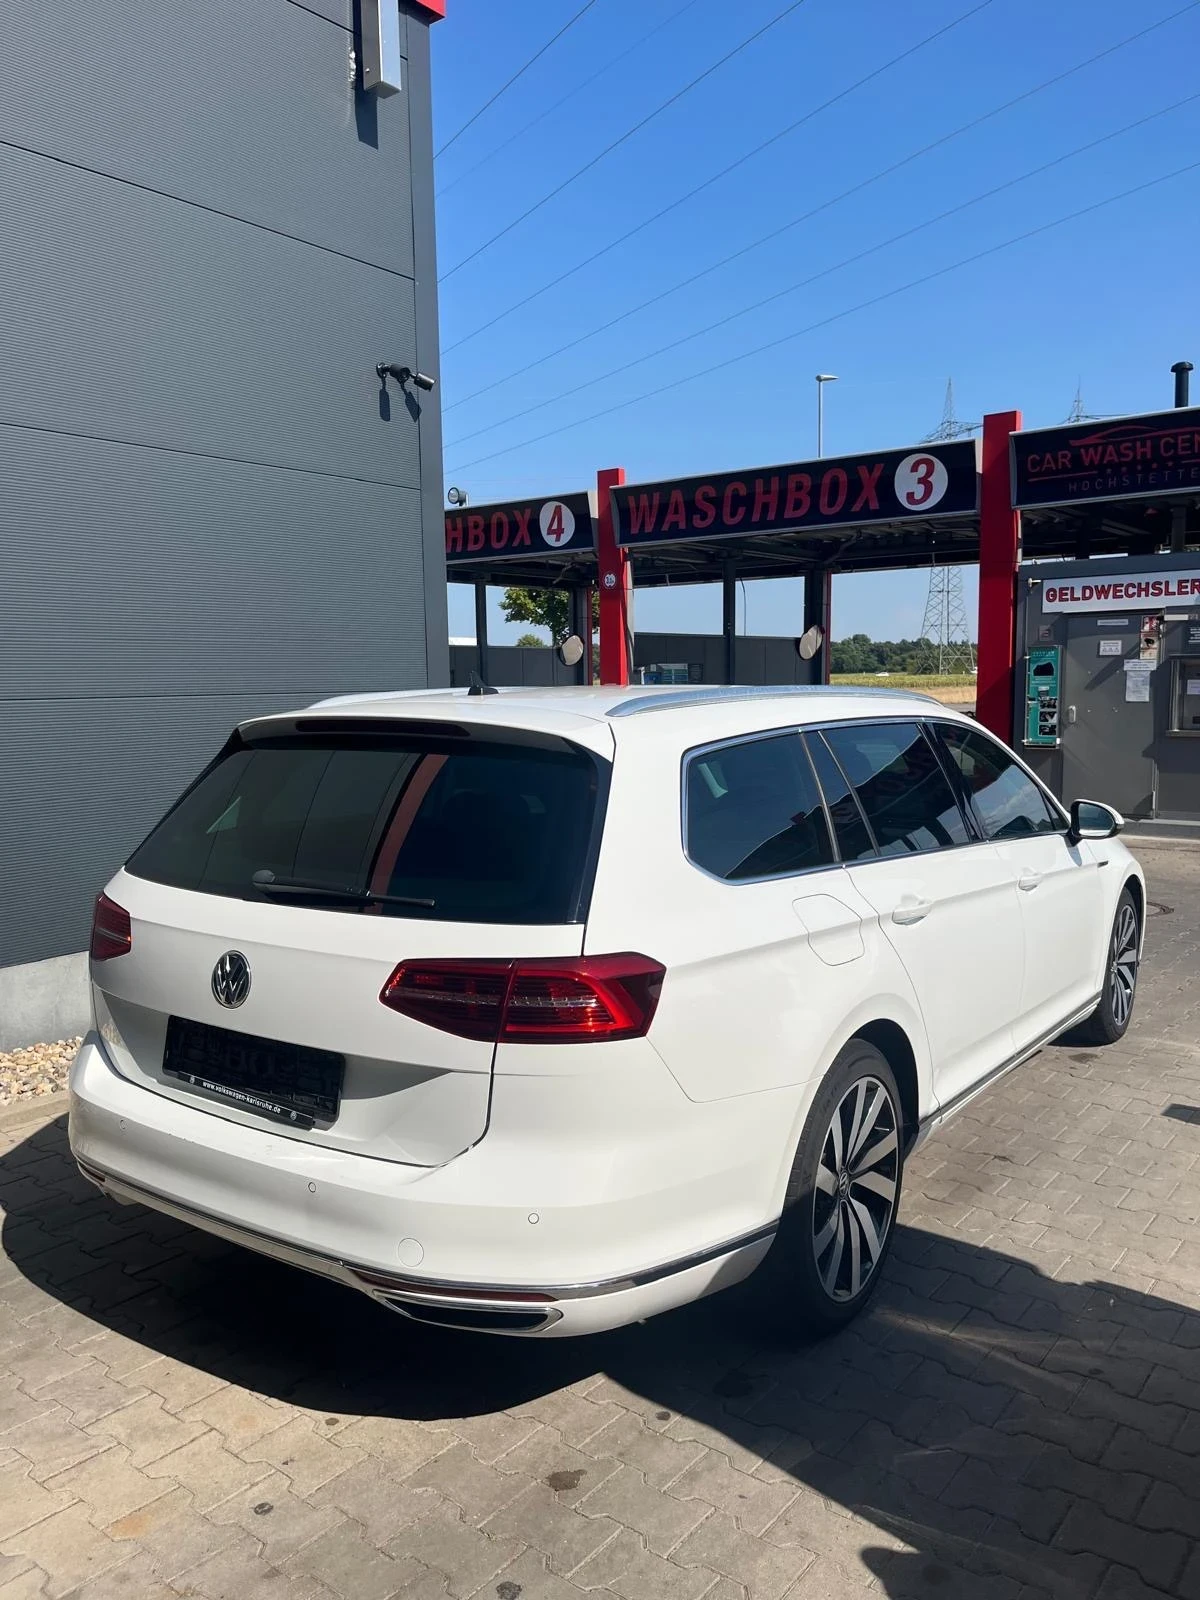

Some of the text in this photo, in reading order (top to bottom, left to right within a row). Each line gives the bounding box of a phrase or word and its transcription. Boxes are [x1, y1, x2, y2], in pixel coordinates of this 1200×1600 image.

[1027, 450, 1072, 473] CAR
[1080, 439, 1152, 466] WASH
[628, 457, 936, 535] WASCHBOX 3
[546, 504, 565, 543] 4
[1045, 578, 1200, 603] GELDWECHSLER
[213, 952, 250, 1007] VW
[202, 1081, 281, 1114] www.volkswagen-karlsruhe.de
